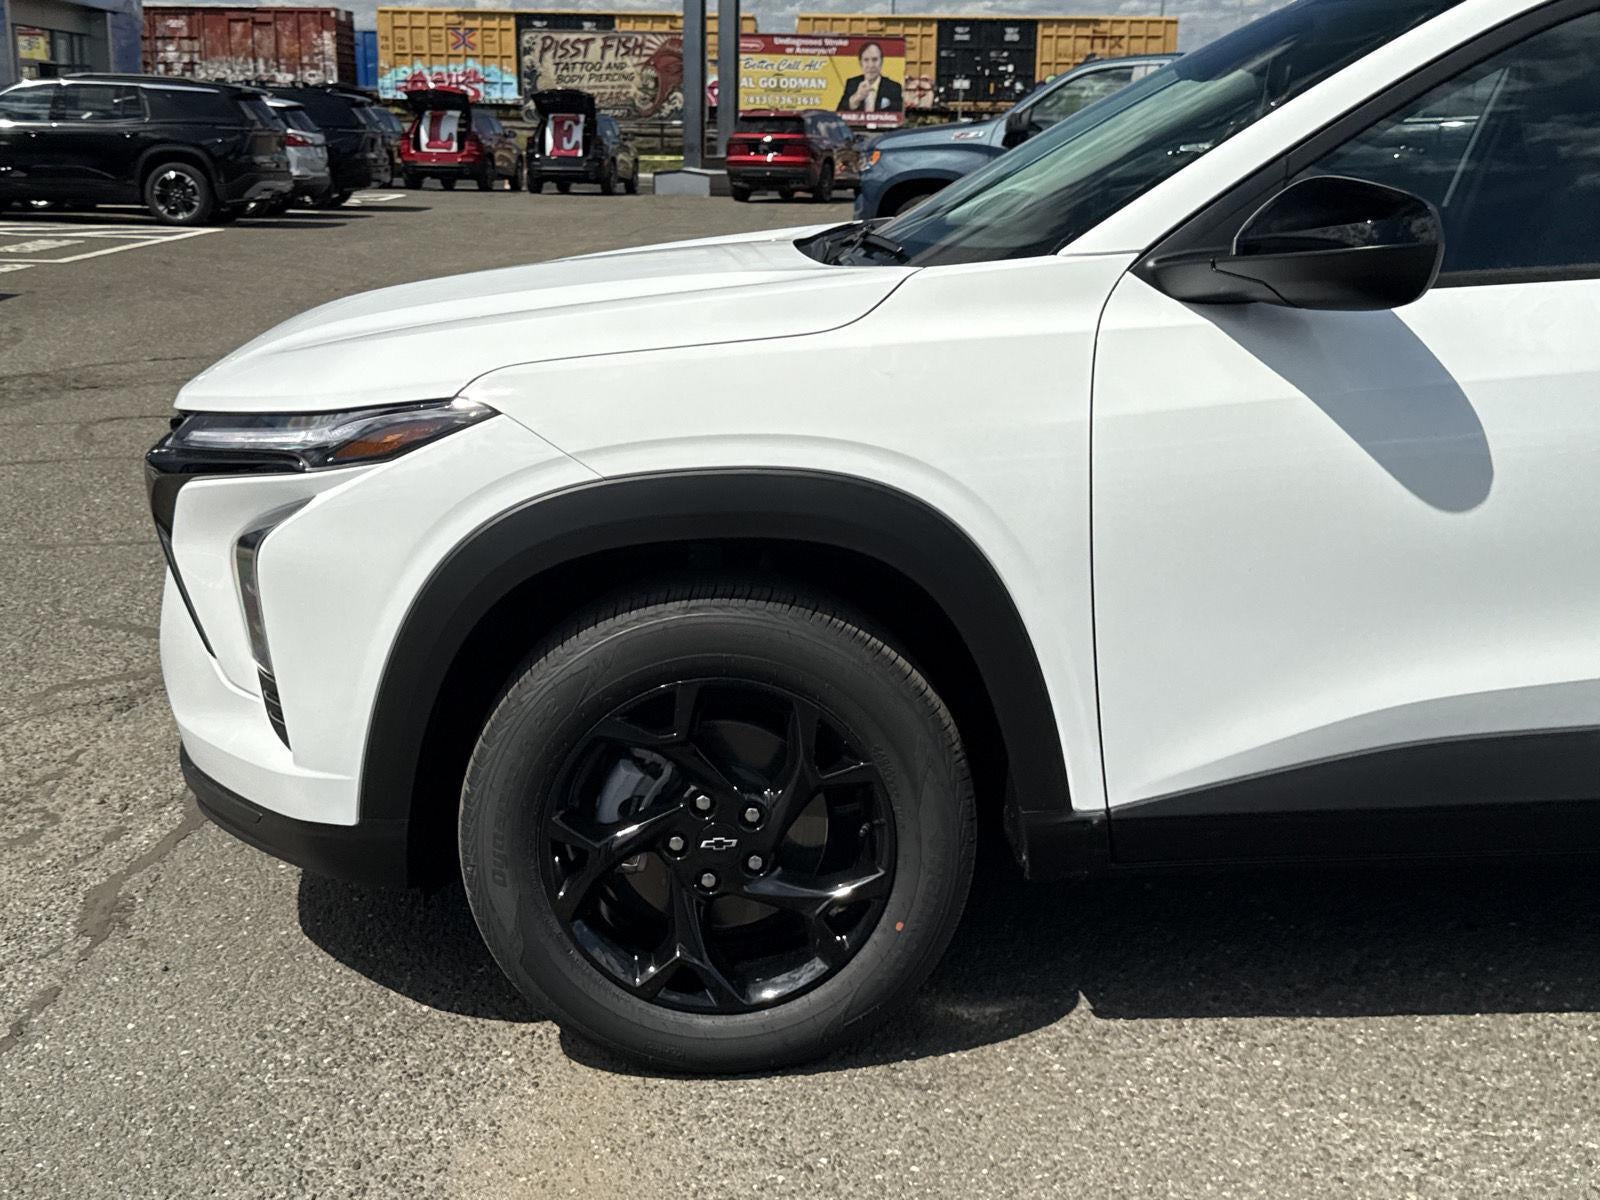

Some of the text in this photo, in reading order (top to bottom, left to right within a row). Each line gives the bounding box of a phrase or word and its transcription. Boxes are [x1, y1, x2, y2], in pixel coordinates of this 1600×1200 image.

[538, 34, 644, 63] PISST FISH
[553, 62, 627, 75] TATTOO AND
[776, 58, 801, 73] Call
[556, 73, 635, 84] BODY PIERCING
[740, 77, 756, 89] AL
[427, 111, 454, 149] L
[550, 115, 582, 157] E
